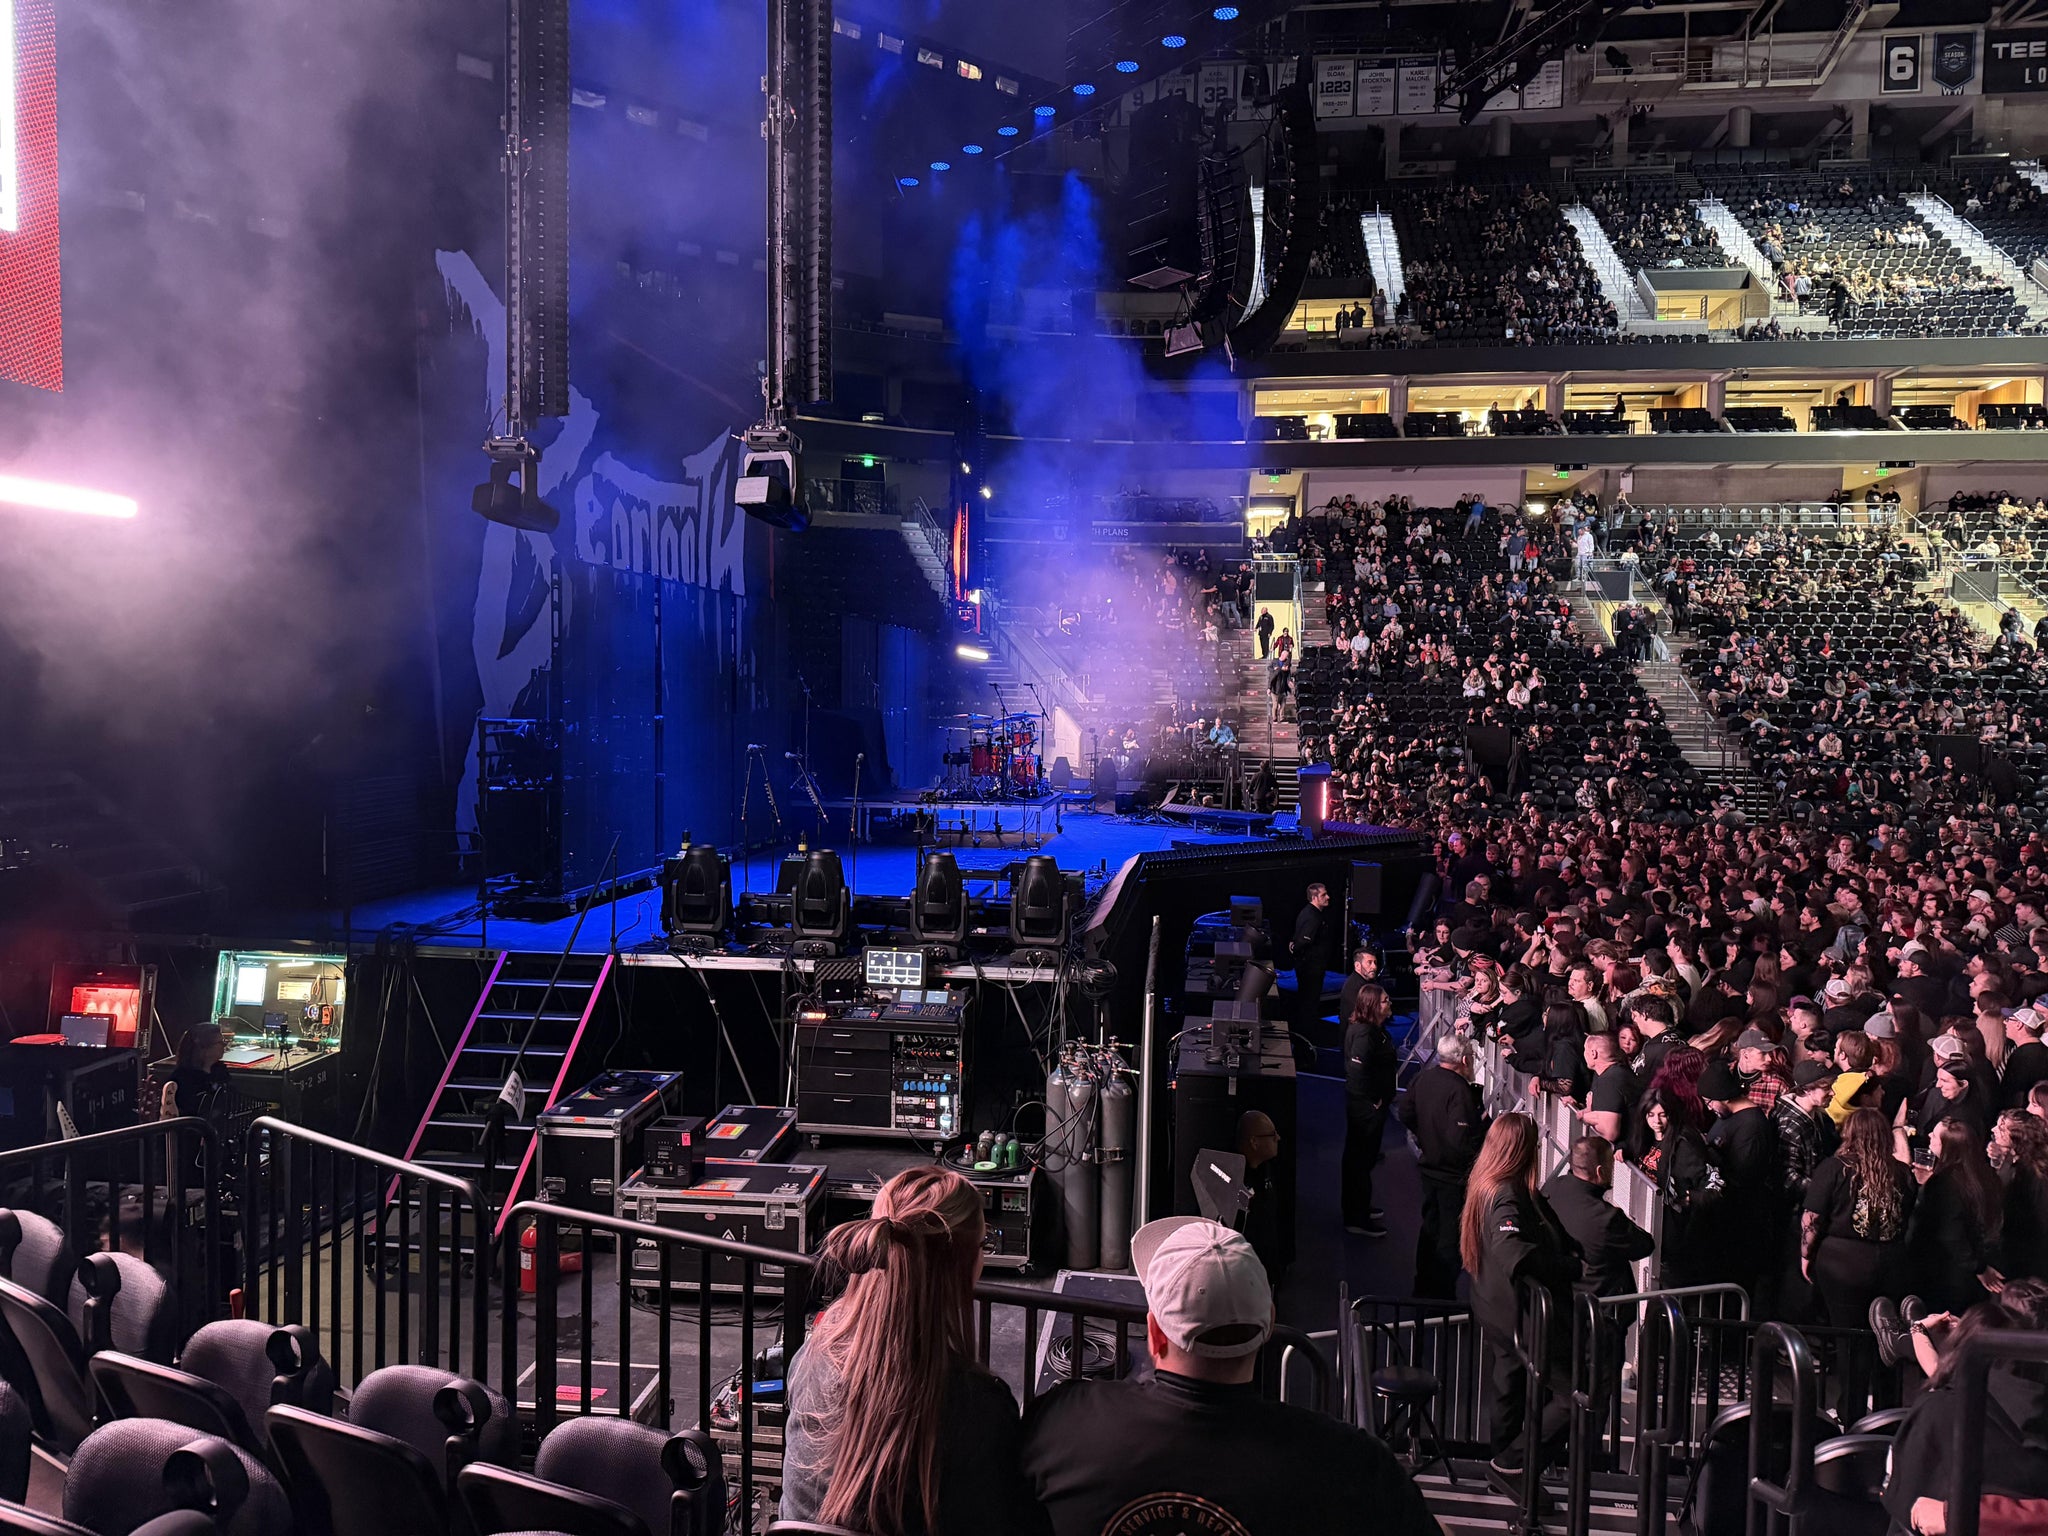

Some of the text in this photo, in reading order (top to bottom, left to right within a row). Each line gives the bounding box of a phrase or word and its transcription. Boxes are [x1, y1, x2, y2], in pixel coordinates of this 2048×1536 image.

[1992, 41, 2047, 59] TEE
[1889, 46, 1915, 81] 6
[1204, 86, 1228, 104] 32
[1320, 80, 1351, 94] 1223
[1103, 528, 1129, 537] PLANS
[1120, 1504, 1174, 1536] SERVICE
[1181, 1506, 1192, 1519] &
